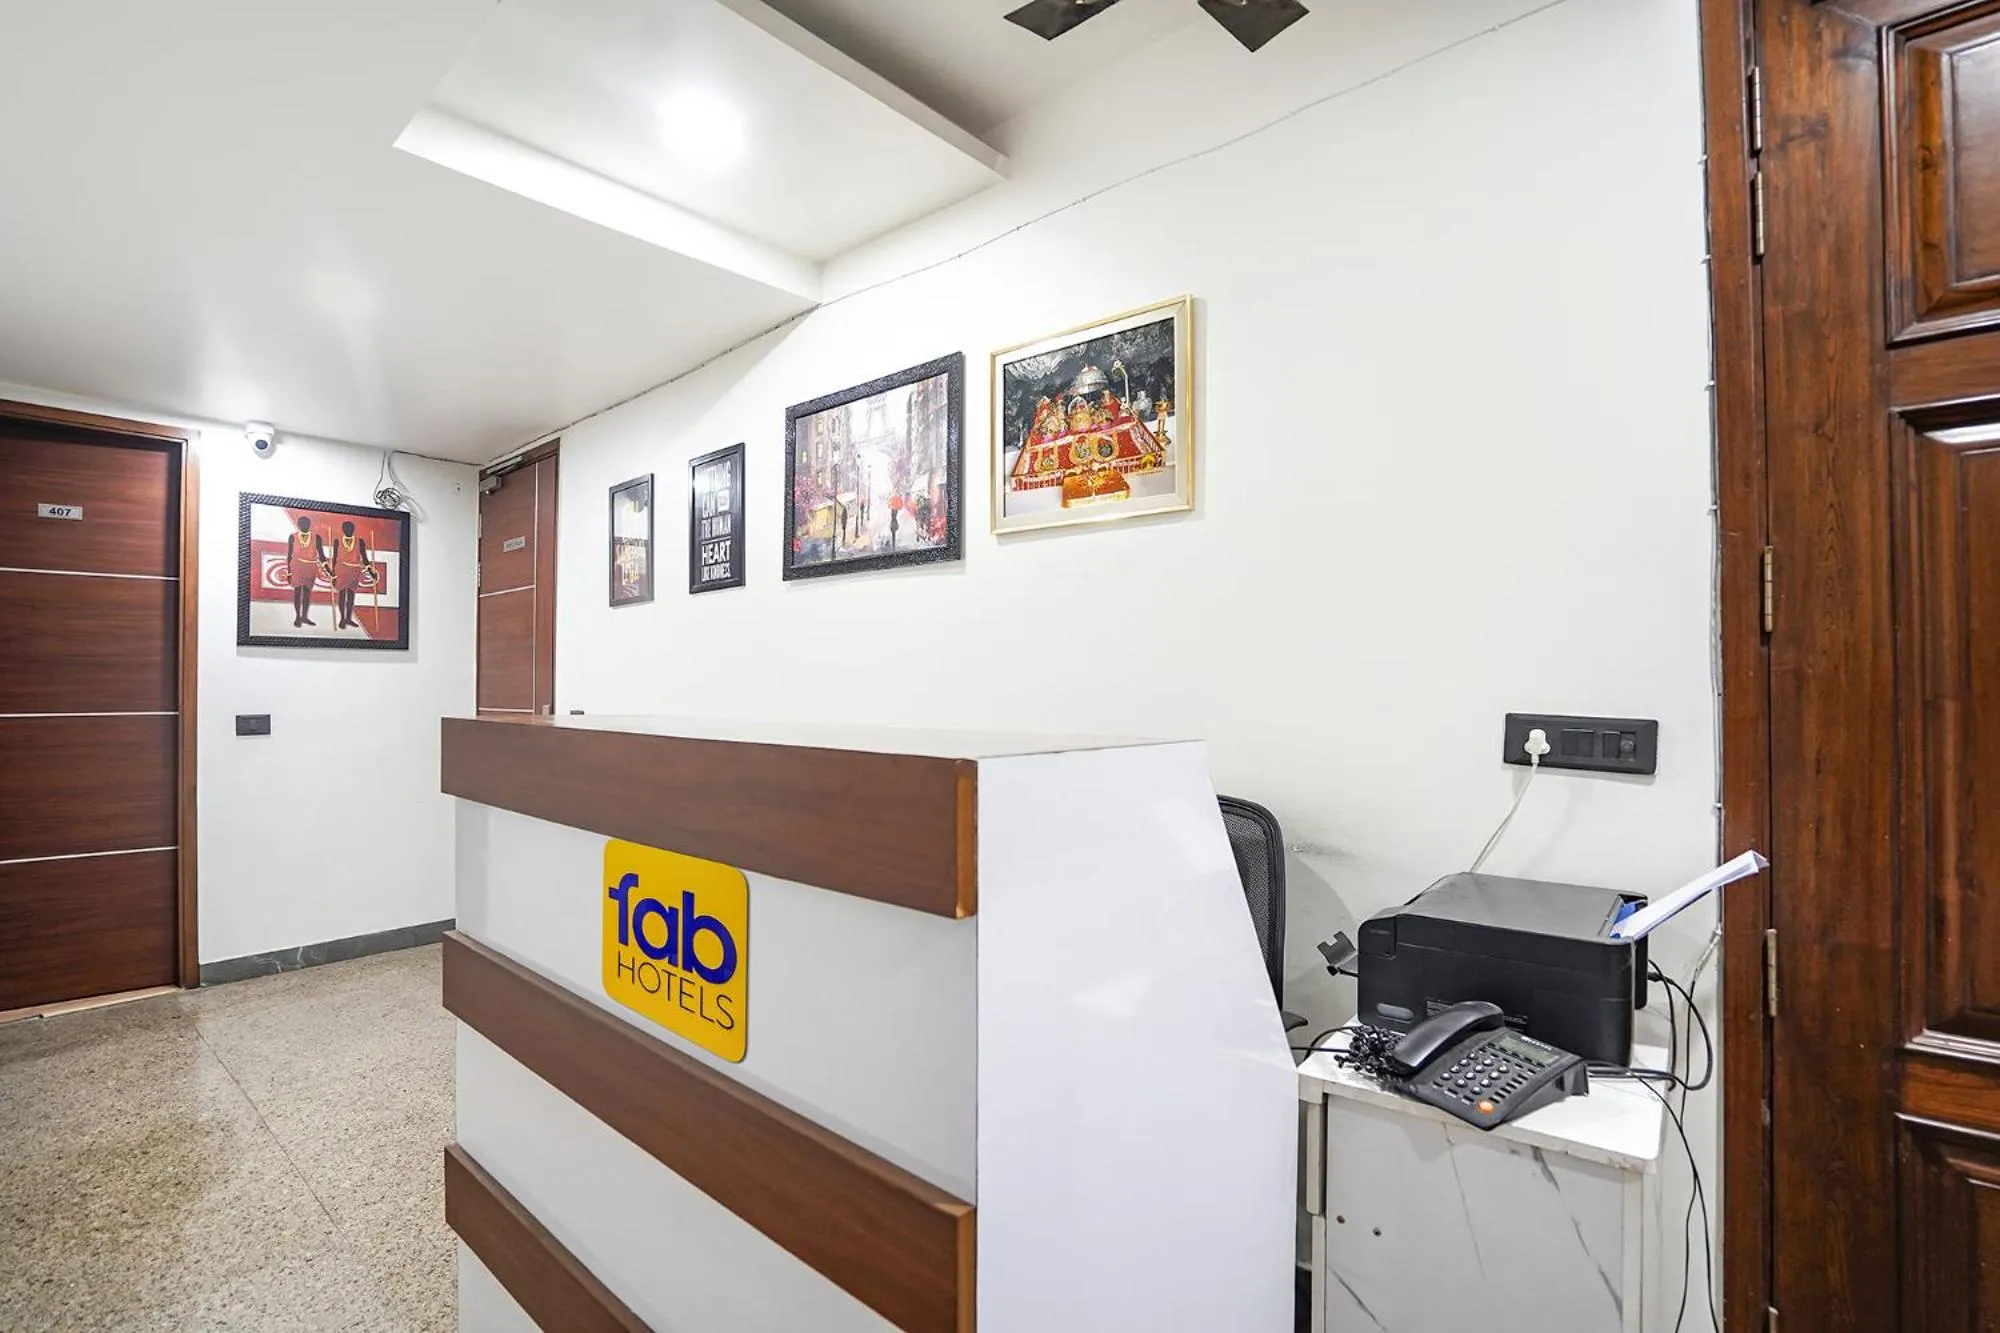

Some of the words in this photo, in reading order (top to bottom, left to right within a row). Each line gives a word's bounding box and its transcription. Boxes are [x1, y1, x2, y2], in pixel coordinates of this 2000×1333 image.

[48, 507, 72, 516] 407
[701, 540, 732, 566] HEART
[608, 872, 738, 985] fab
[617, 950, 735, 1031] HOTELS
